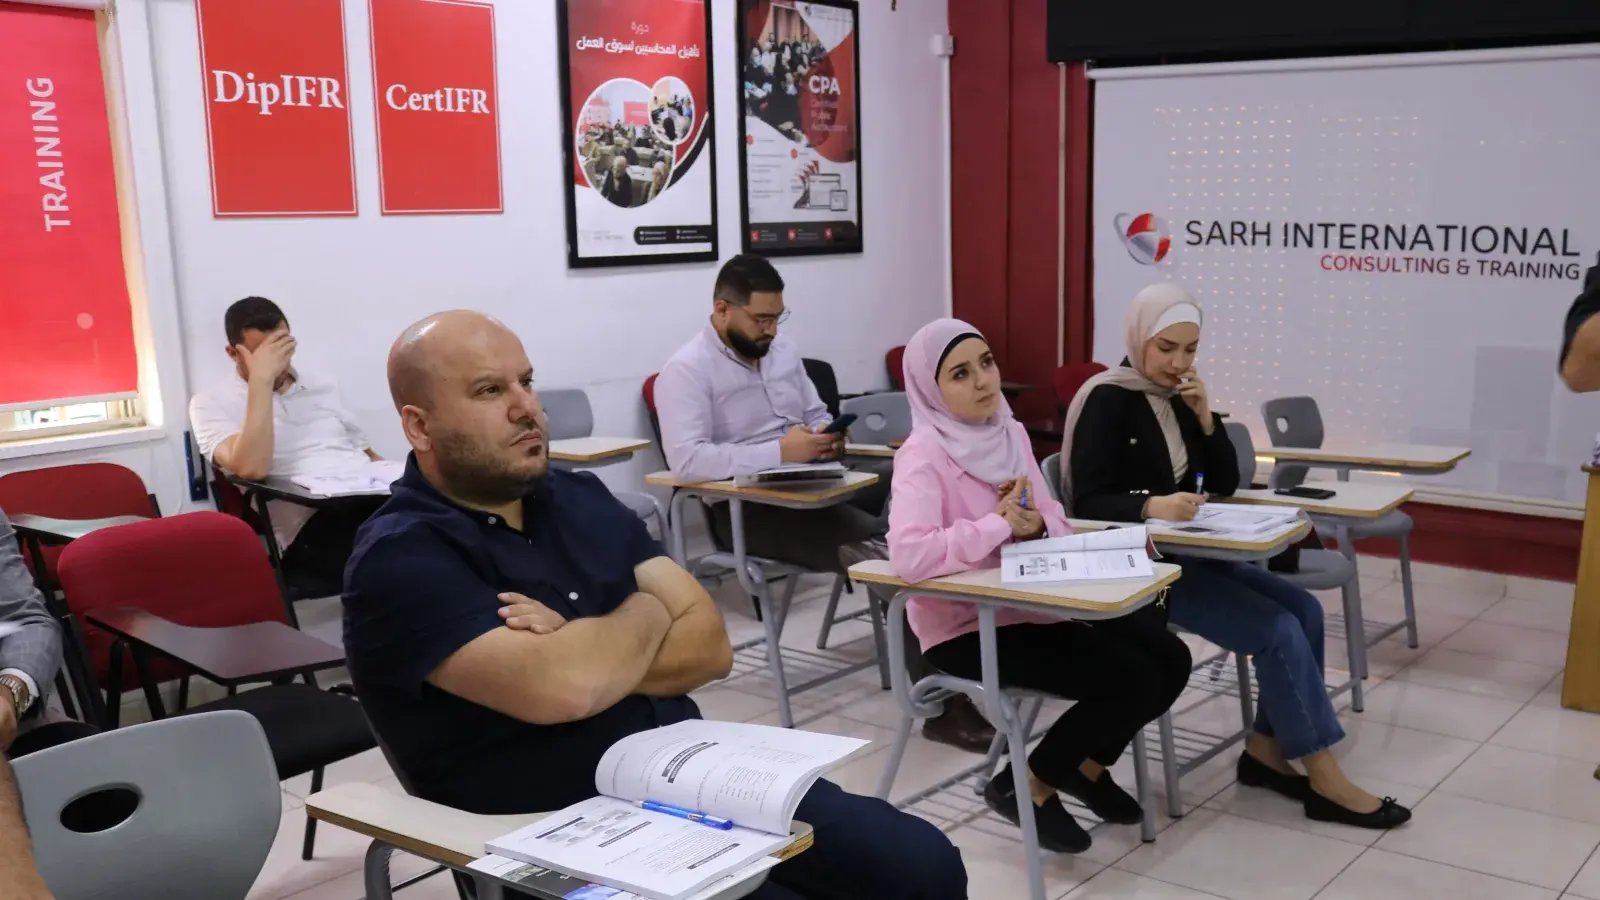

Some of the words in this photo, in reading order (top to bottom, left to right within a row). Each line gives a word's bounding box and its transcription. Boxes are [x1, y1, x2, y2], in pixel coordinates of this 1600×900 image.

[630, 21, 649, 35] دورة
[576, 36, 604, 50] العمل
[212, 70, 344, 115] DipIFR
[385, 84, 490, 114] CertIFR
[808, 75, 841, 95] CPA
[27, 77, 70, 231] TRAINING
[1185, 220, 1271, 247] SARH
[1283, 223, 1580, 257] INTERNATIONAL
[1320, 254, 1450, 275] CONSULTING
[1456, 258, 1471, 275] &
[1477, 259, 1580, 280] TRAINING
